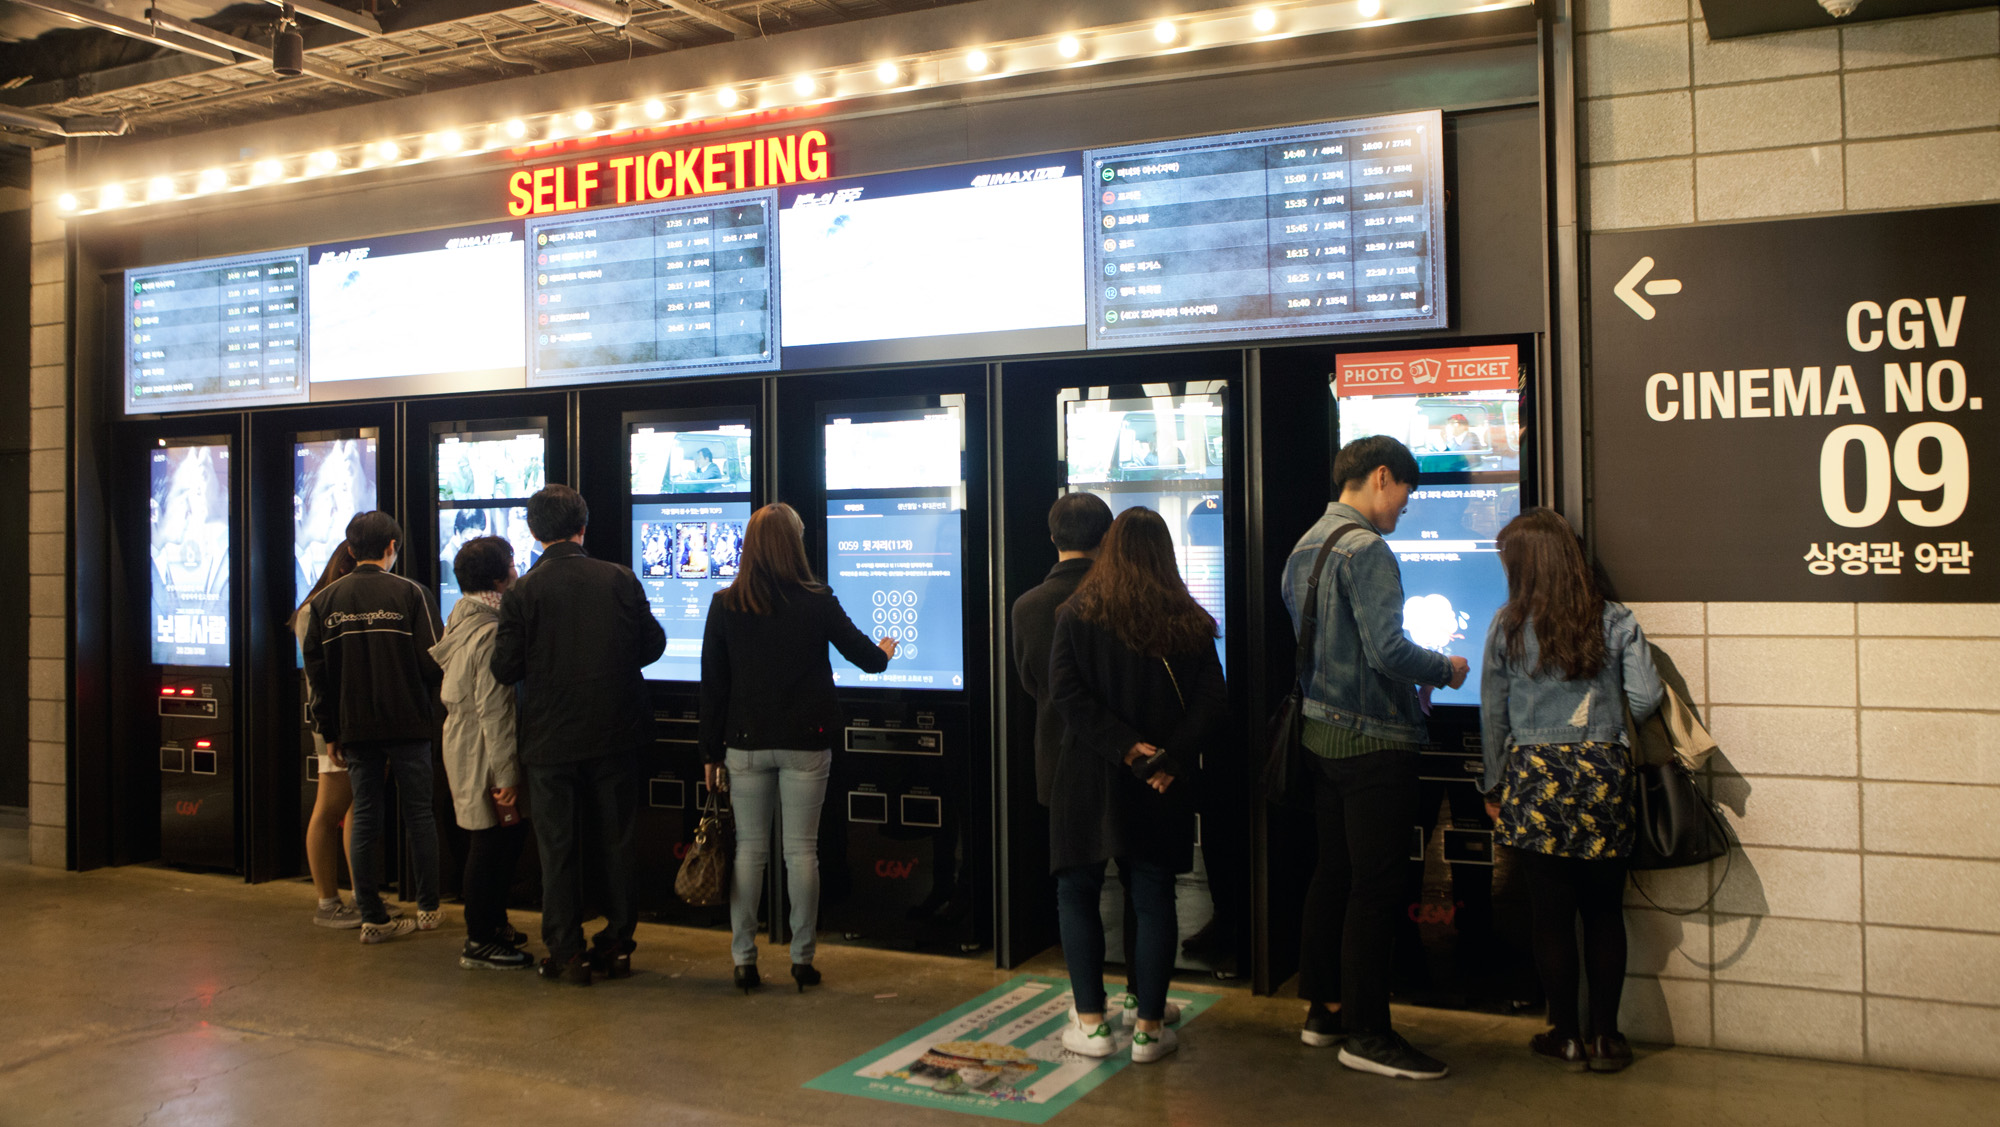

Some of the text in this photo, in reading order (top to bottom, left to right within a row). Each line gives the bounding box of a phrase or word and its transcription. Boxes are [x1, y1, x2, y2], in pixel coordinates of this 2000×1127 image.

[1283, 149, 1306, 159] 14:40
[508, 130, 828, 216] SELF TICKETING
[1284, 174, 1306, 184] 15:00
[1285, 199, 1307, 209] 15:35
[1285, 224, 1308, 234] 15:45
[1286, 249, 1308, 259] 16:15
[1287, 274, 1309, 283] 16:25
[1288, 298, 1310, 308] 16:40
[1846, 296, 1967, 352] CGV
[1344, 367, 1403, 382] PHOTO
[1447, 362, 1508, 378] TICKET
[1645, 359, 1983, 422] CINEMA NO.
[1819, 421, 1970, 528] 09
[838, 541, 859, 550] 0059
[1803, 541, 1973, 575] 상영관 9관
[324, 608, 404, 628] Champion
[874, 859, 913, 879] CGV
